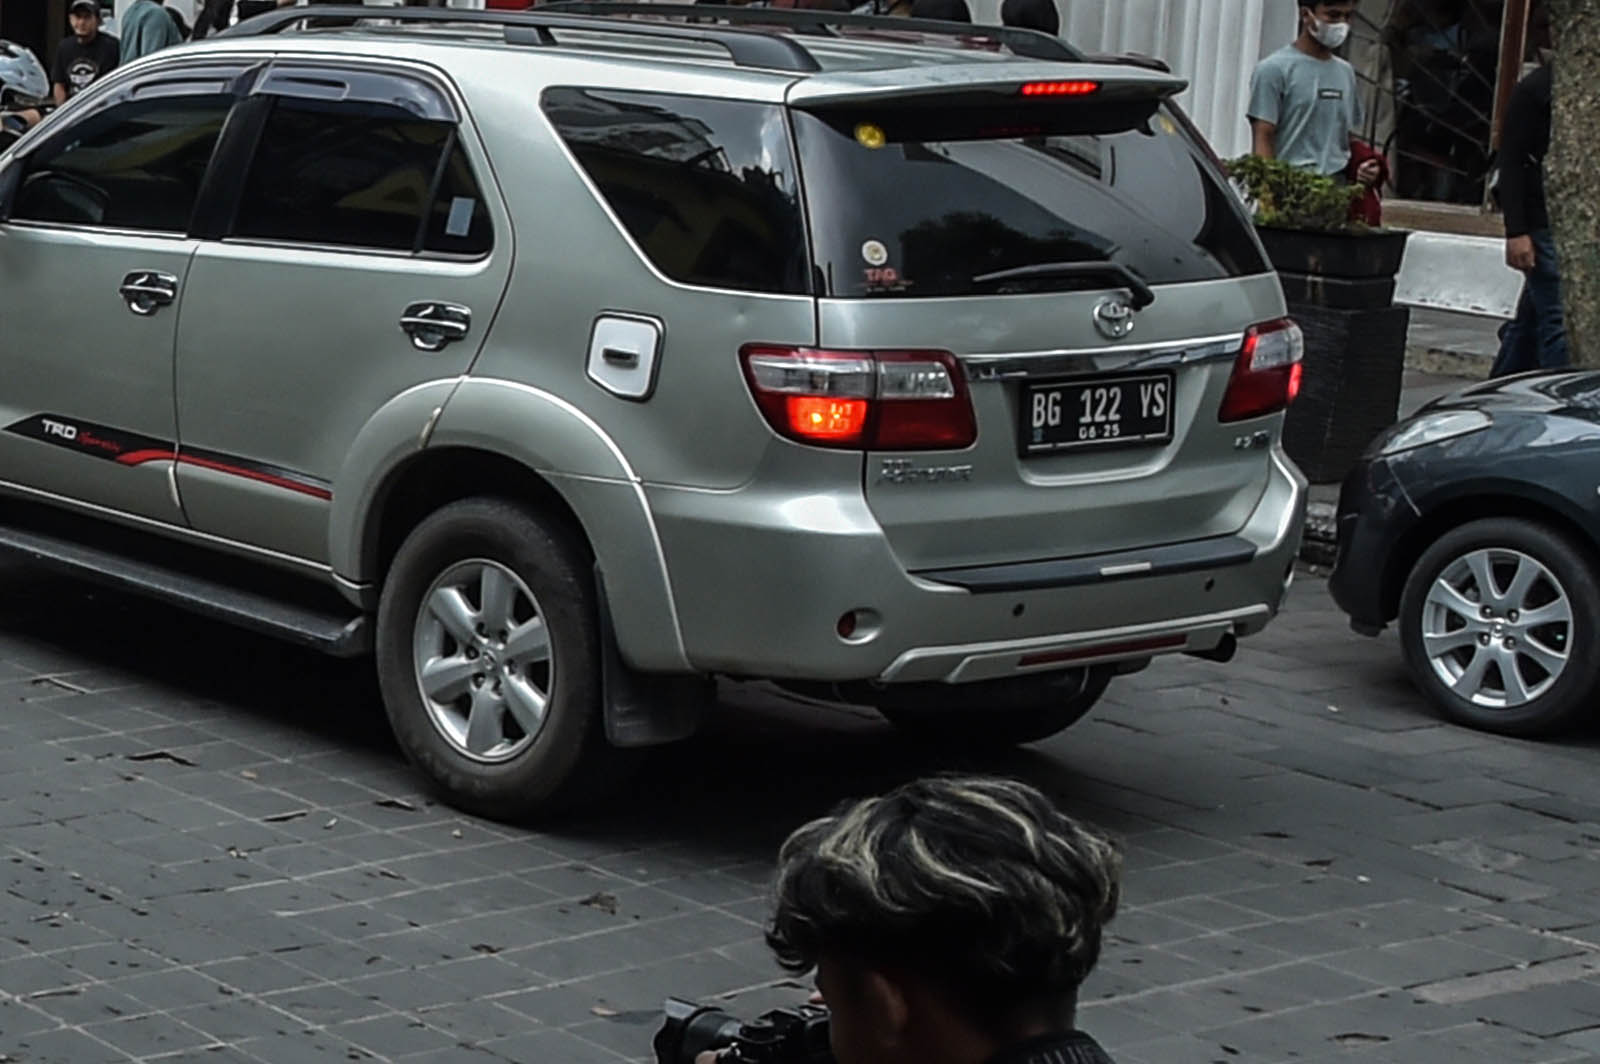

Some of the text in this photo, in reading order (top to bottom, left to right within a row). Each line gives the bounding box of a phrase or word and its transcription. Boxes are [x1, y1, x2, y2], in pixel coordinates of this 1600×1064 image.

[1032, 382, 1166, 428] BG 122 YS
[41, 418, 78, 440] TRD
